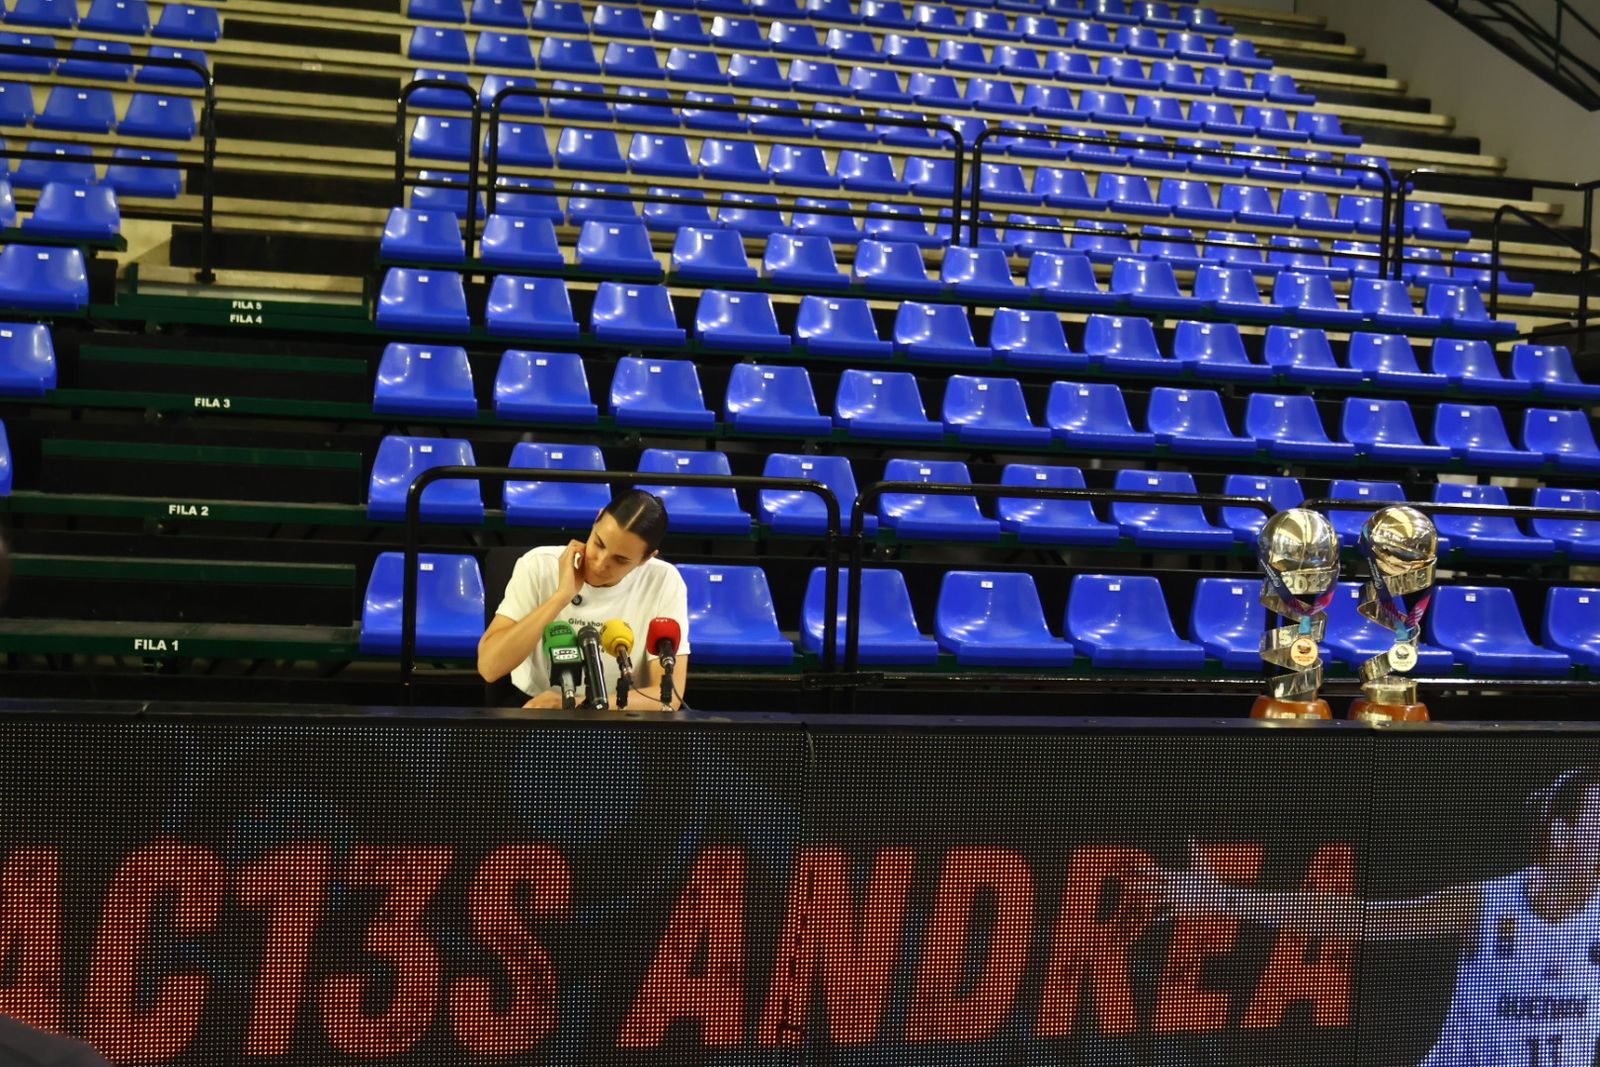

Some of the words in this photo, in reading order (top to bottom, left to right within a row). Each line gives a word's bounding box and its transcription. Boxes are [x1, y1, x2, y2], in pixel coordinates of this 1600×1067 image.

[232, 301, 254, 310] FILA
[230, 314, 254, 324] FILA
[255, 315, 262, 324] 4
[194, 397, 220, 408] FILA
[223, 398, 230, 408] 3
[168, 504, 198, 516] FILA
[200, 506, 209, 516] 2
[568, 617, 586, 626] Girls
[134, 639, 167, 651] FILA
[171, 640, 179, 651] 1
[614, 843, 1356, 1048] ANDREA
